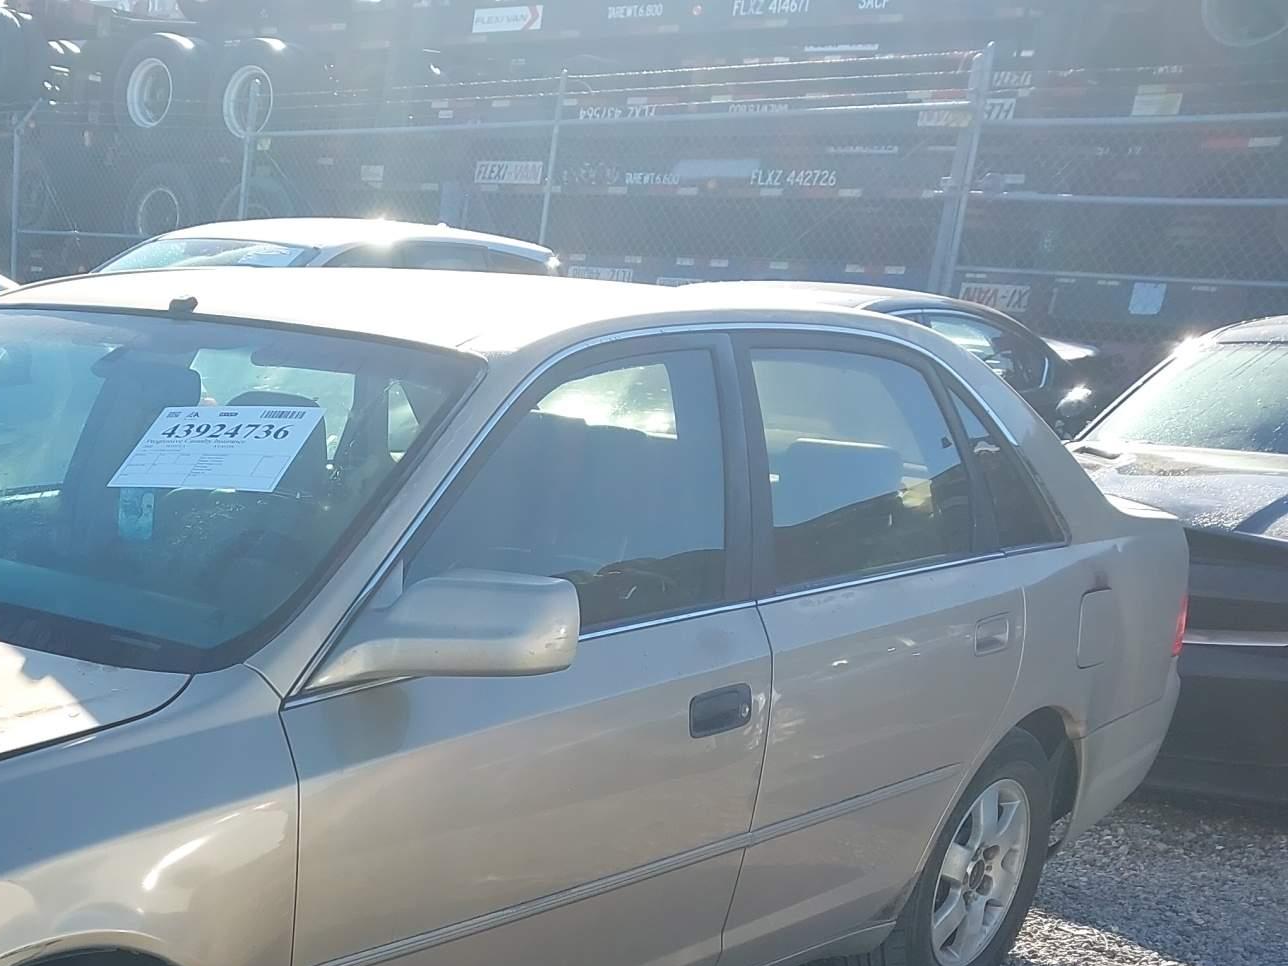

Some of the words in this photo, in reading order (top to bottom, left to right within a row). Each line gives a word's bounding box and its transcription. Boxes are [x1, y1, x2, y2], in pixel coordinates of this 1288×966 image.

[750, 169, 782, 186] FLXZ
[786, 170, 837, 187] 442726
[161, 422, 295, 440] 43924736
